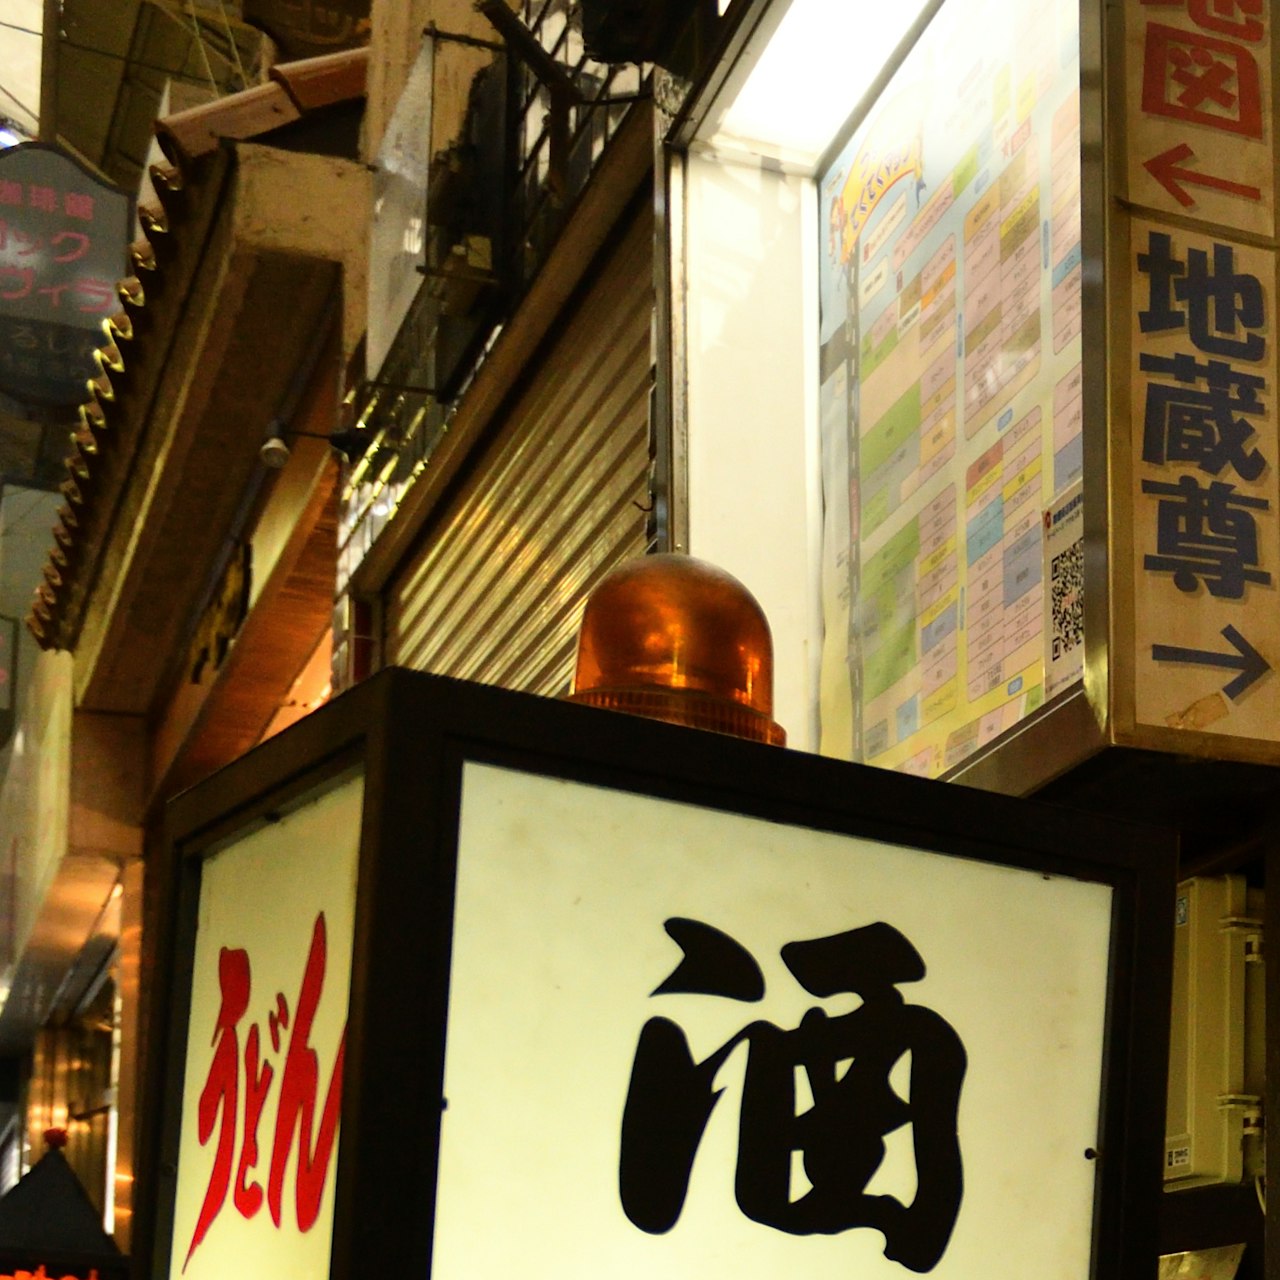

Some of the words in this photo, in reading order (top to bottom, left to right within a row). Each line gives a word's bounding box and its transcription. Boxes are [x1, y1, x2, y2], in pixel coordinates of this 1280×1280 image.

[1136, 231, 1273, 599] 地蔵尊
[181, 911, 349, 1275] うどん
[619, 916, 967, 1274] 酒
